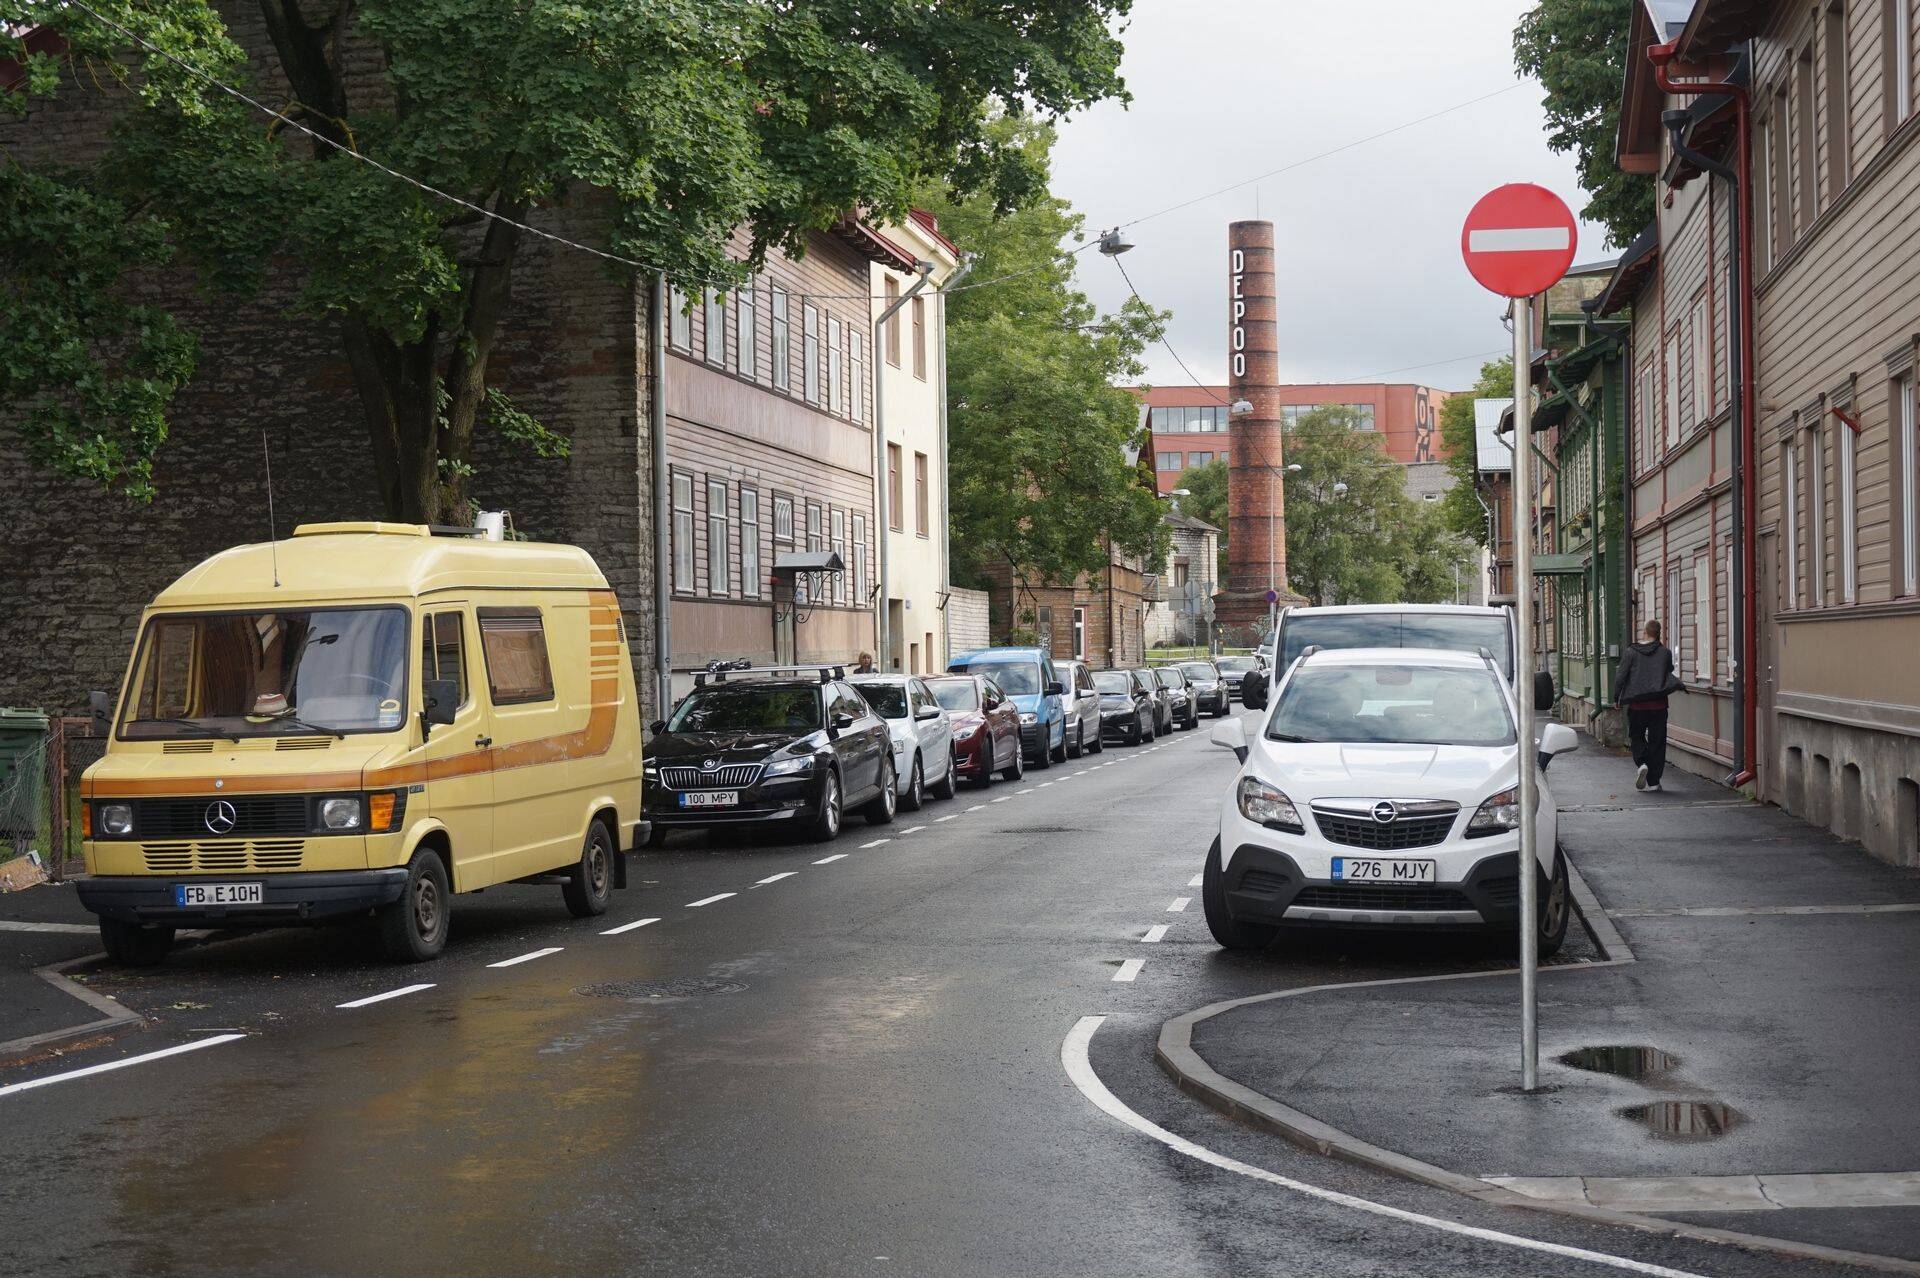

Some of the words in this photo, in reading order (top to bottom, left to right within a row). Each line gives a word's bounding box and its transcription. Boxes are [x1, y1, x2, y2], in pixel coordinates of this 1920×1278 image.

[1232, 249, 1246, 377] DEPOO
[689, 794, 705, 804] 100
[711, 793, 734, 803] MPY
[1350, 861, 1382, 878] 276
[1392, 862, 1429, 879] MJY
[186, 887, 205, 903] FB
